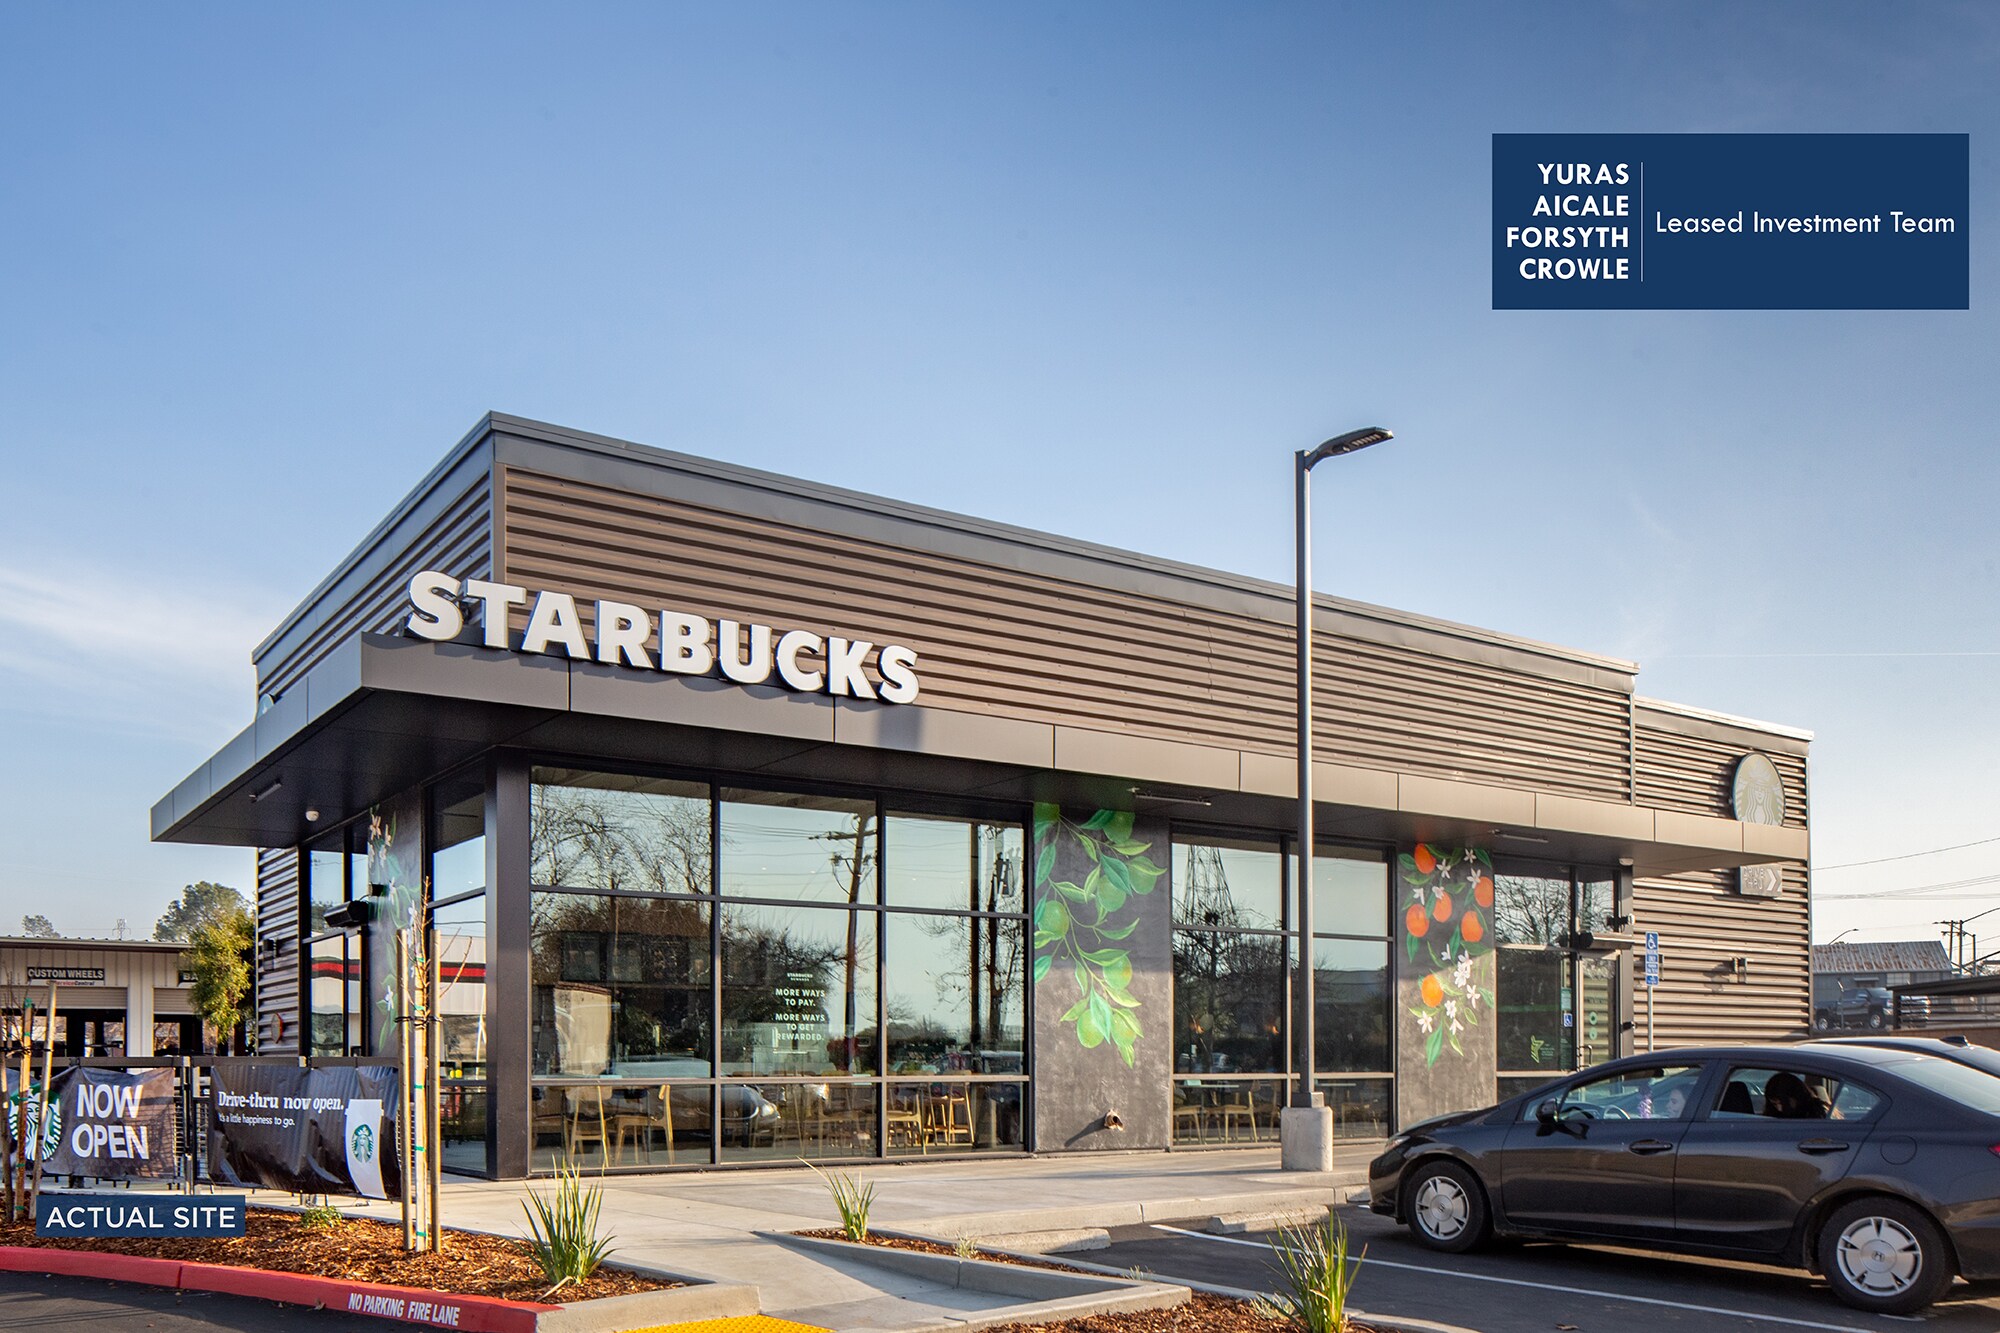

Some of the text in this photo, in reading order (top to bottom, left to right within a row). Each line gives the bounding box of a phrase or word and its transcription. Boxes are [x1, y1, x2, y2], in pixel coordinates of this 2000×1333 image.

[406, 571, 920, 704] STARBUCKS
[28, 968, 104, 979] CUSTOM WHEELS
[775, 988, 826, 997] MORE WAYS
[785, 998, 816, 1007] TO PAY.
[775, 1013, 825, 1021] MORE WAYS
[786, 1023, 814, 1031] TO GET
[777, 1033, 824, 1041] REWARDED.
[77, 1084, 144, 1118] NOW
[218, 1091, 279, 1109] Drive-thru
[312, 1097, 344, 1114] open.
[242, 1113, 273, 1126] happiness
[274, 1116, 282, 1125] to
[282, 1118, 295, 1129] go.
[72, 1123, 149, 1159] OPEN
[348, 1293, 461, 1326] NO PARKING FIRE LANE
